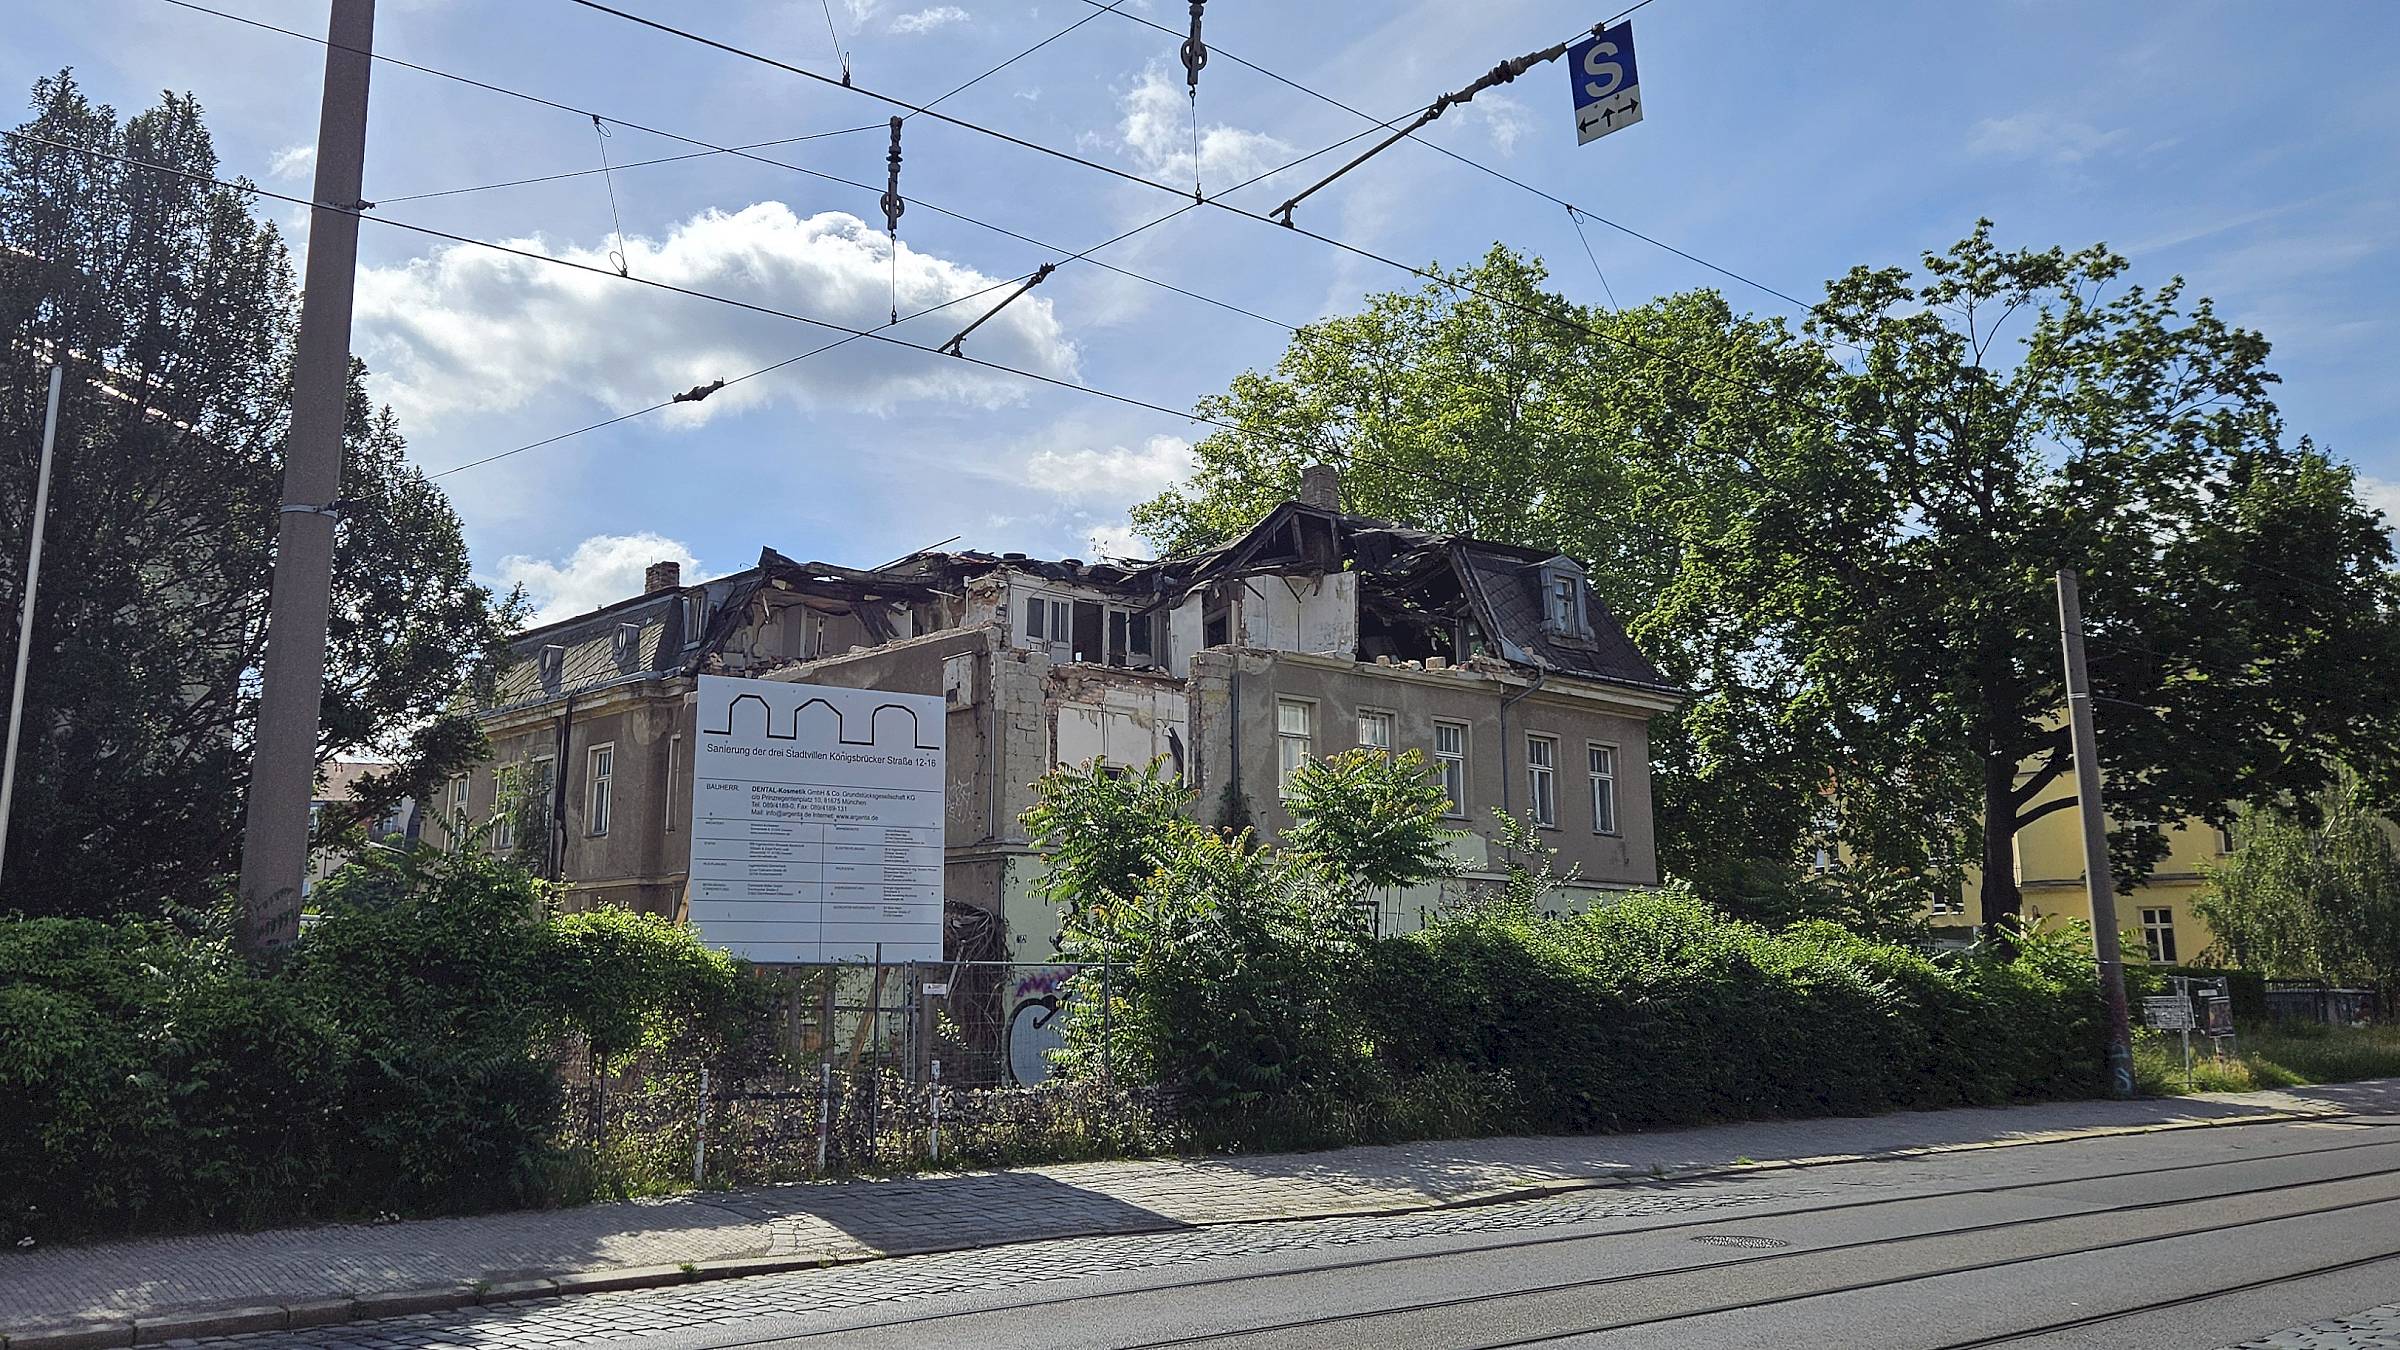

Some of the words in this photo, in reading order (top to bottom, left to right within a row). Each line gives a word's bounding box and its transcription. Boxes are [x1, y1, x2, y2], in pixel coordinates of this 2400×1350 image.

[1584, 42, 1623, 97] S
[707, 743, 750, 757] Sanierung
[752, 747, 767, 756] der
[768, 748, 784, 757] drei
[785, 748, 828, 760] Stadtvillen
[829, 751, 885, 764] Königsbrücker
[887, 755, 913, 766] Straße
[915, 758, 937, 768] 12-16
[751, 785, 806, 795] DENTAL-Kosmetik
[807, 788, 825, 797] GmbH
